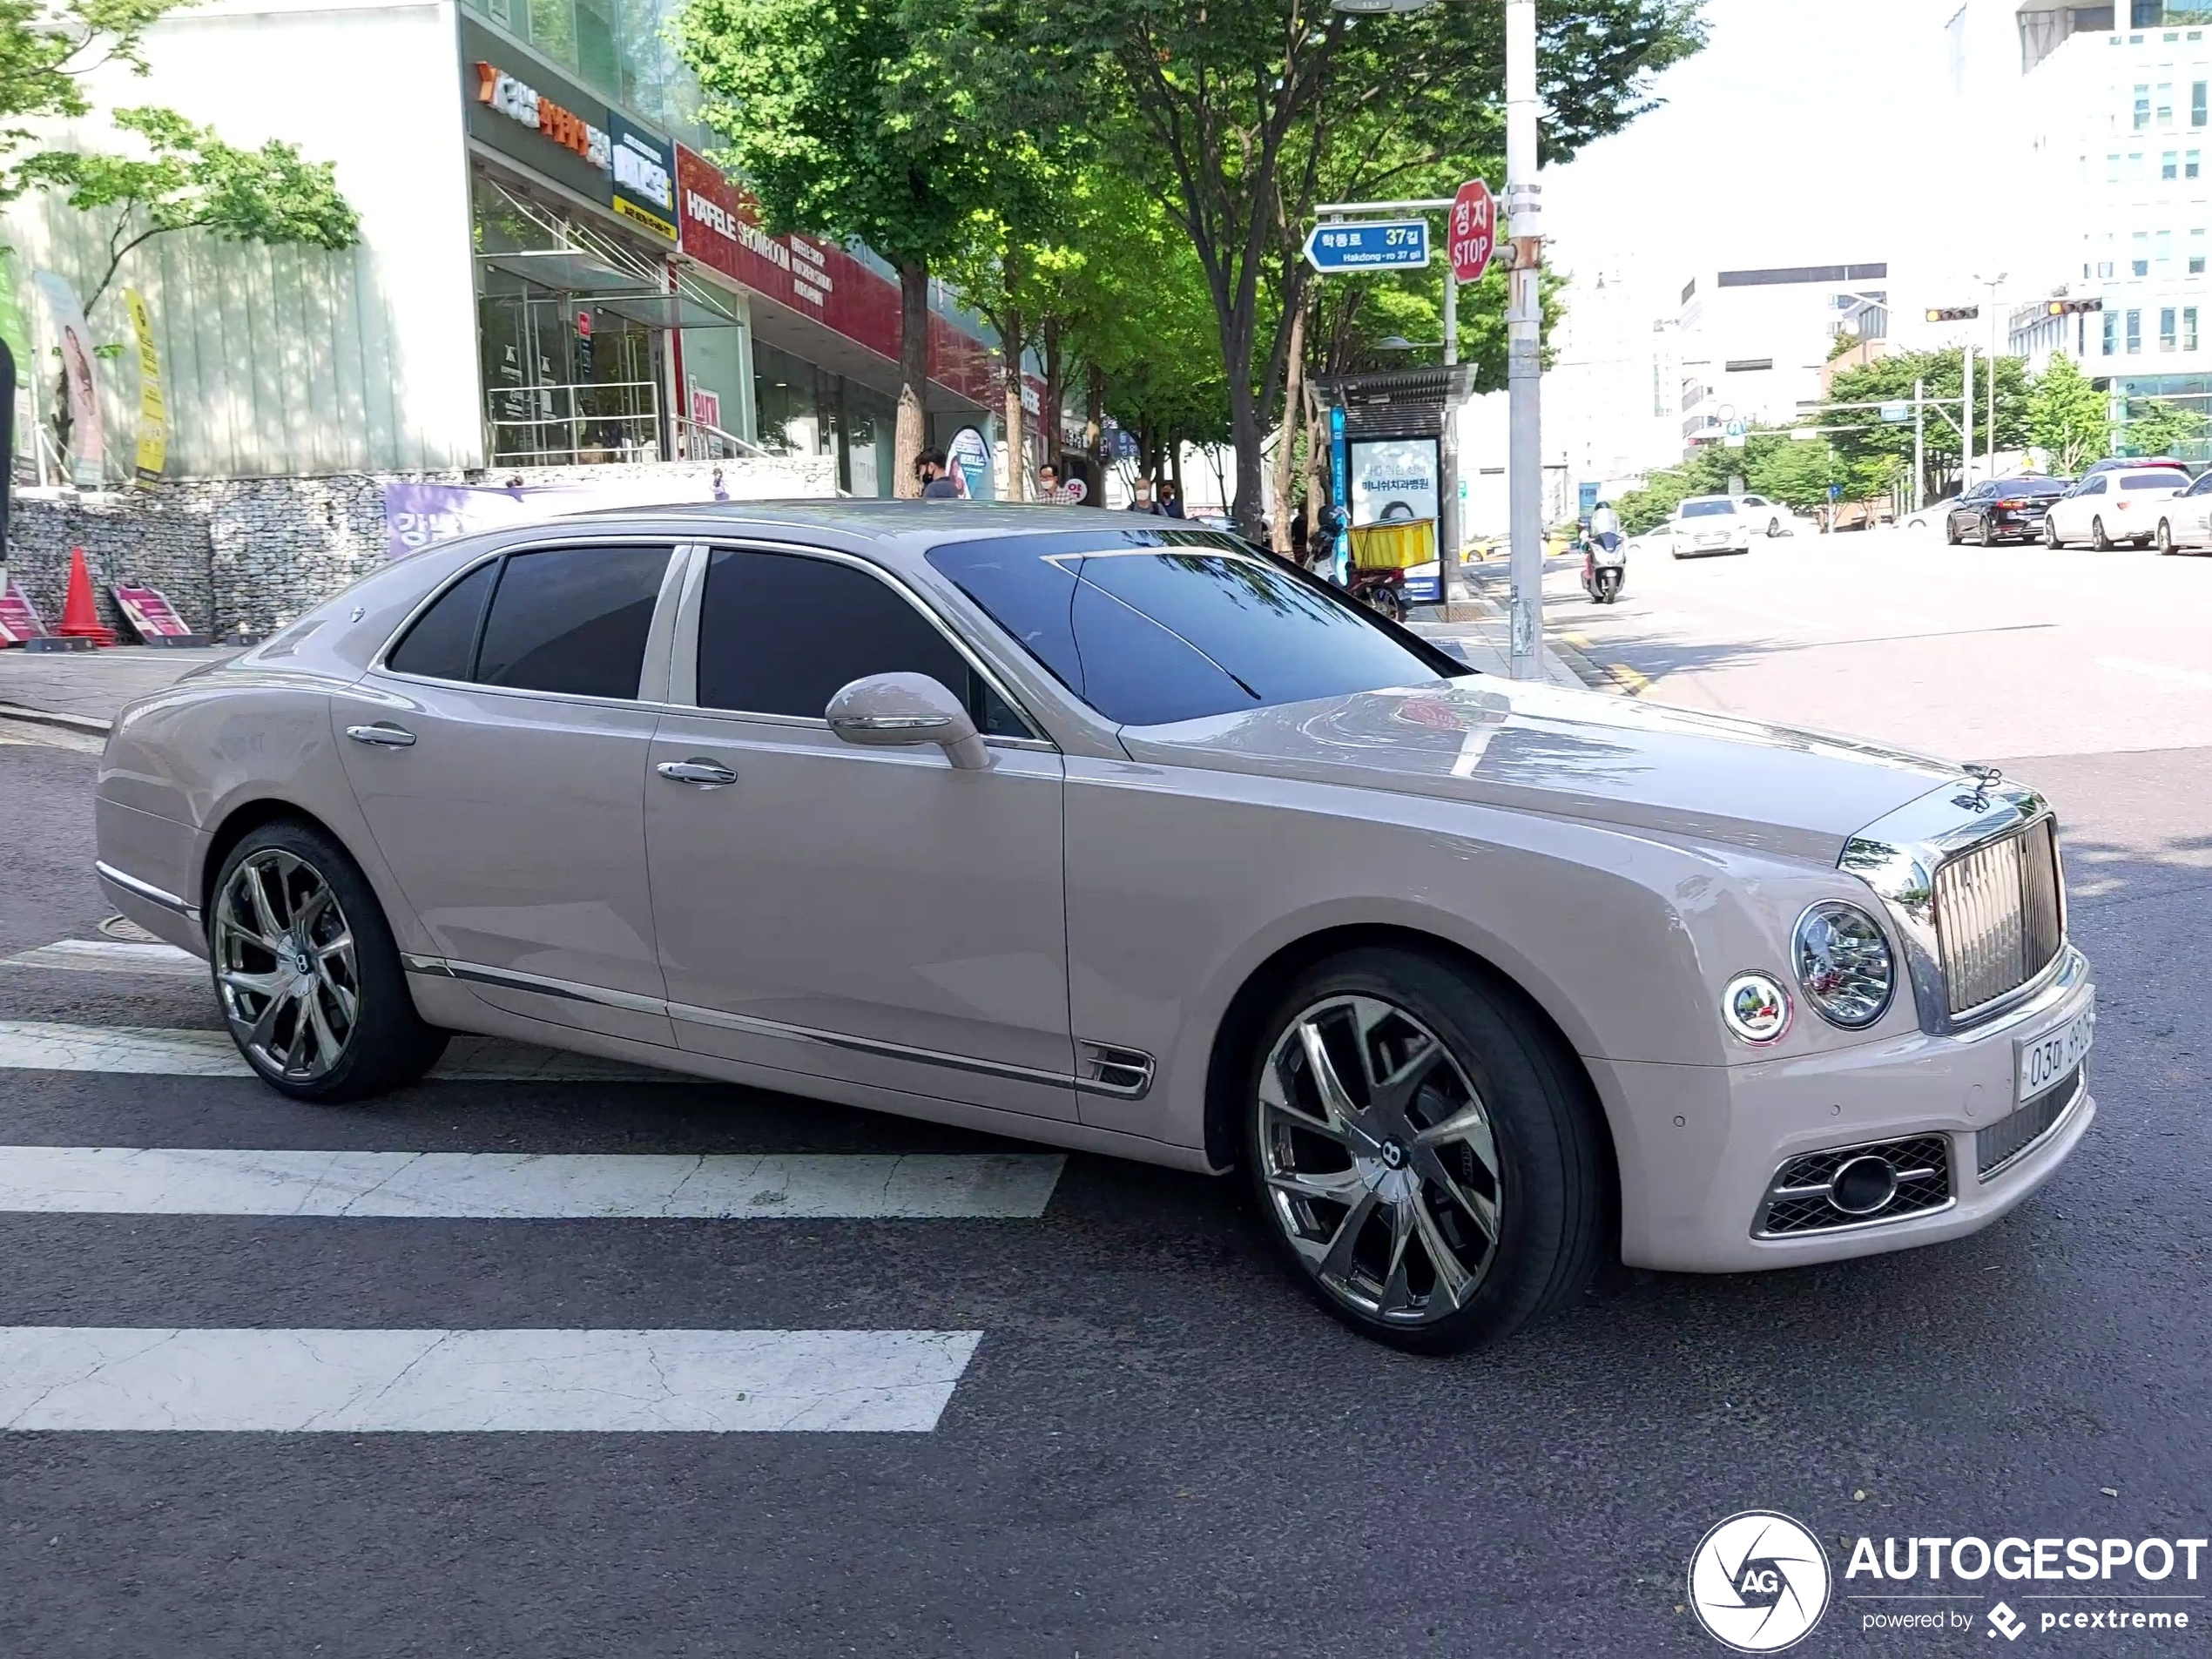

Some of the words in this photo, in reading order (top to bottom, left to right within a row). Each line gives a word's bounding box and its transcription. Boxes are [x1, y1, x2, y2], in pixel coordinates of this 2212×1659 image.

[1456, 194, 1487, 235] 정지
[1321, 233, 1362, 247] 학동로
[1386, 229, 1419, 245] 37길
[1397, 251, 1408, 260] 37
[1453, 236, 1487, 268] STOP
[1362, 478, 1429, 492] 미니쉬치과병원
